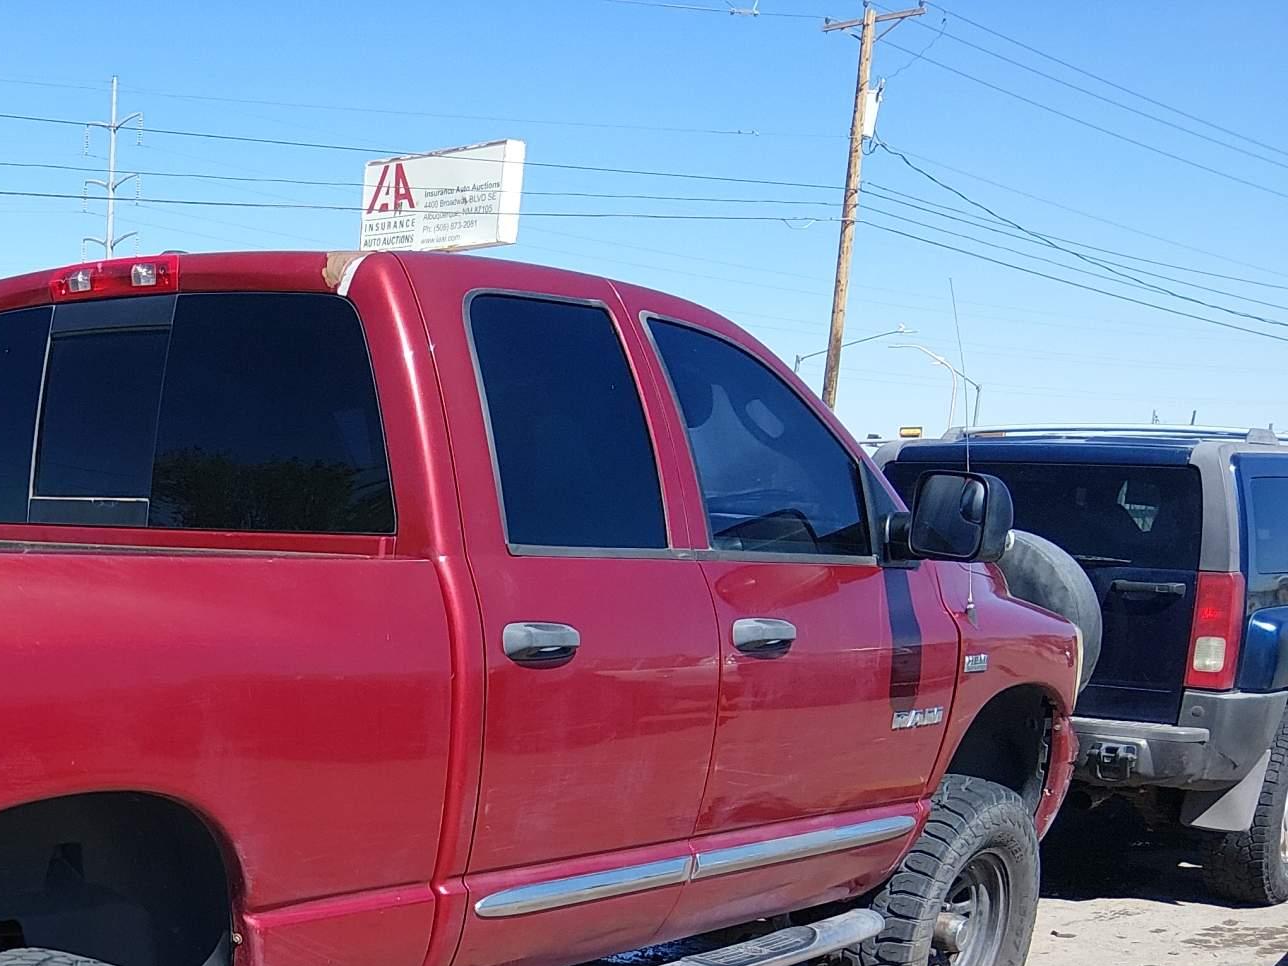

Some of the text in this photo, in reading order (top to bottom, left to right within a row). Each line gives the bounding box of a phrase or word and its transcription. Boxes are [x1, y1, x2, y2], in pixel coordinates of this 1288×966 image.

[424, 180, 500, 198] Insurance Auto Auctions
[364, 218, 415, 233] INSURANCE
[363, 233, 414, 248] AUTO AUCTIONS
[892, 706, 944, 730] RAM
